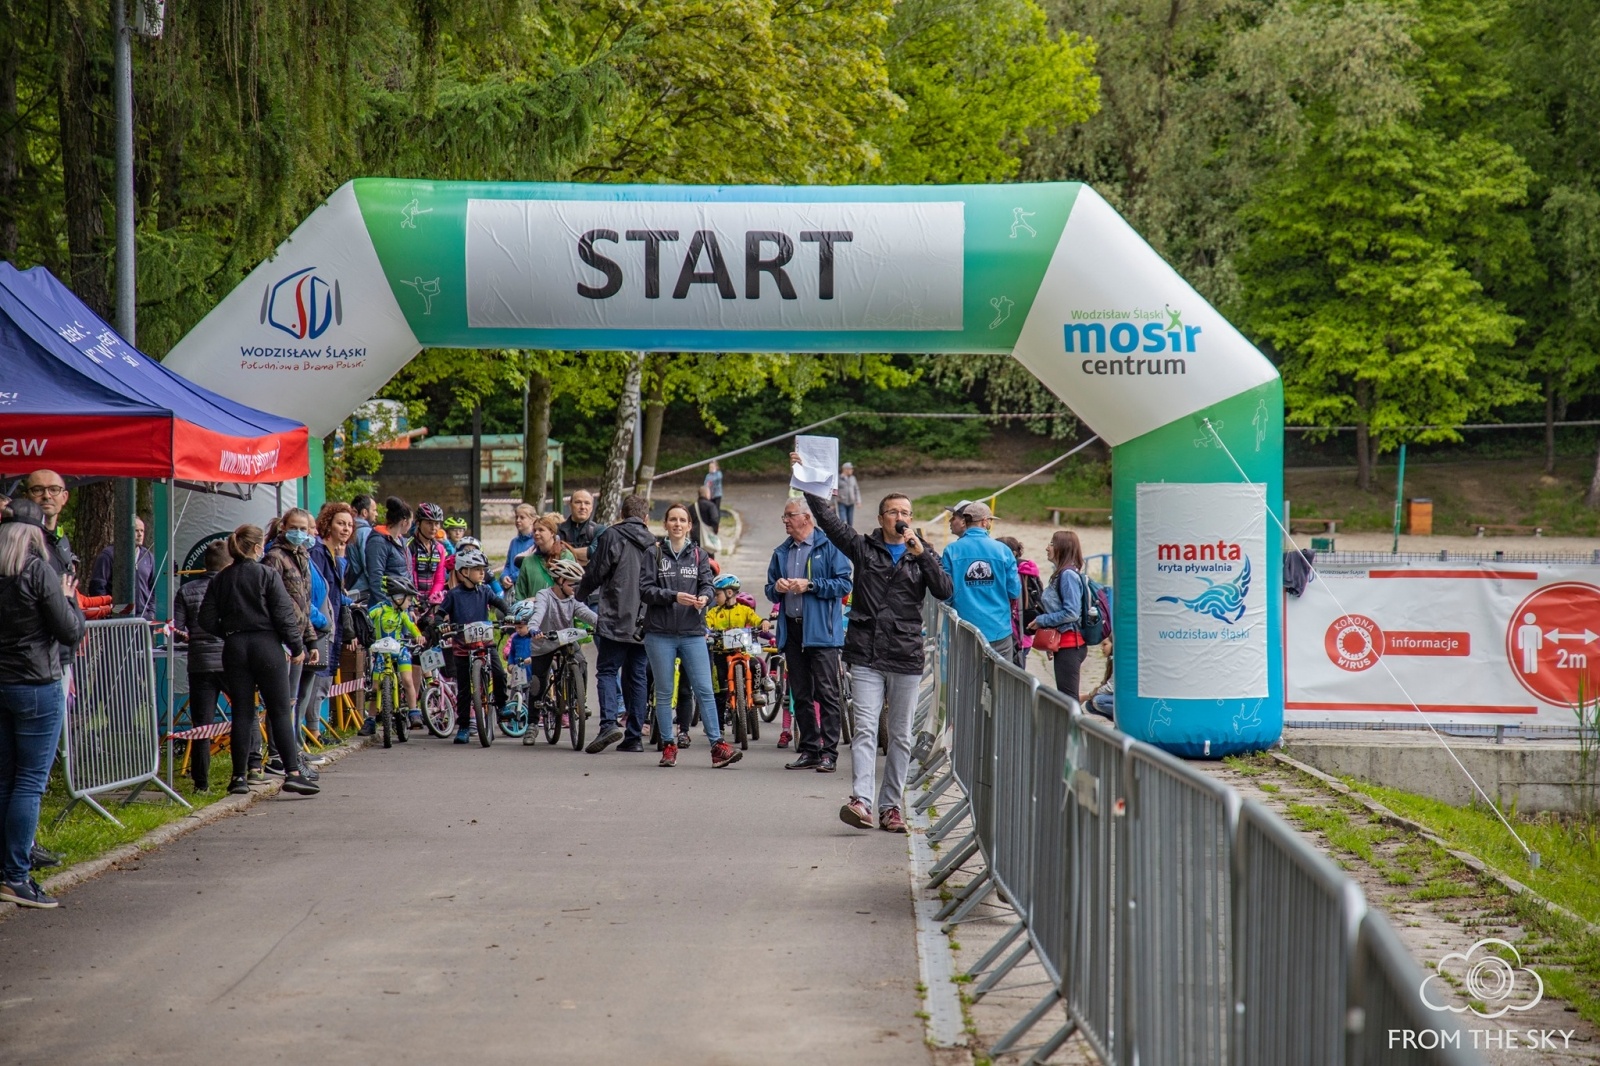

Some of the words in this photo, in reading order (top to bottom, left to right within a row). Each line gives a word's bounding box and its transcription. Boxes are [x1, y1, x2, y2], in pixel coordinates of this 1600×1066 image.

[576, 228, 854, 300] START
[1070, 309, 1131, 320] Wodzisław
[1133, 307, 1163, 321] Śląski
[1063, 322, 1202, 353] mosir
[240, 346, 322, 358] WODZISŁAW
[325, 345, 367, 360] ŚLĄSKI
[302, 360, 334, 371] Brama
[1081, 355, 1186, 375] centrum
[1157, 540, 1242, 561] manta
[1157, 563, 1183, 573] kryta
[1185, 563, 1232, 573] pływalnia
[473, 626, 484, 636] 19
[1334, 617, 1375, 632] KORONA
[566, 630, 579, 638] 24
[1158, 628, 1218, 639] wodzisław
[1220, 627, 1250, 641] śląski
[1391, 637, 1459, 651] informacje
[428, 656, 433, 664] 4
[1337, 657, 1371, 669] WIRUS
[1556, 648, 1587, 669] 2m
